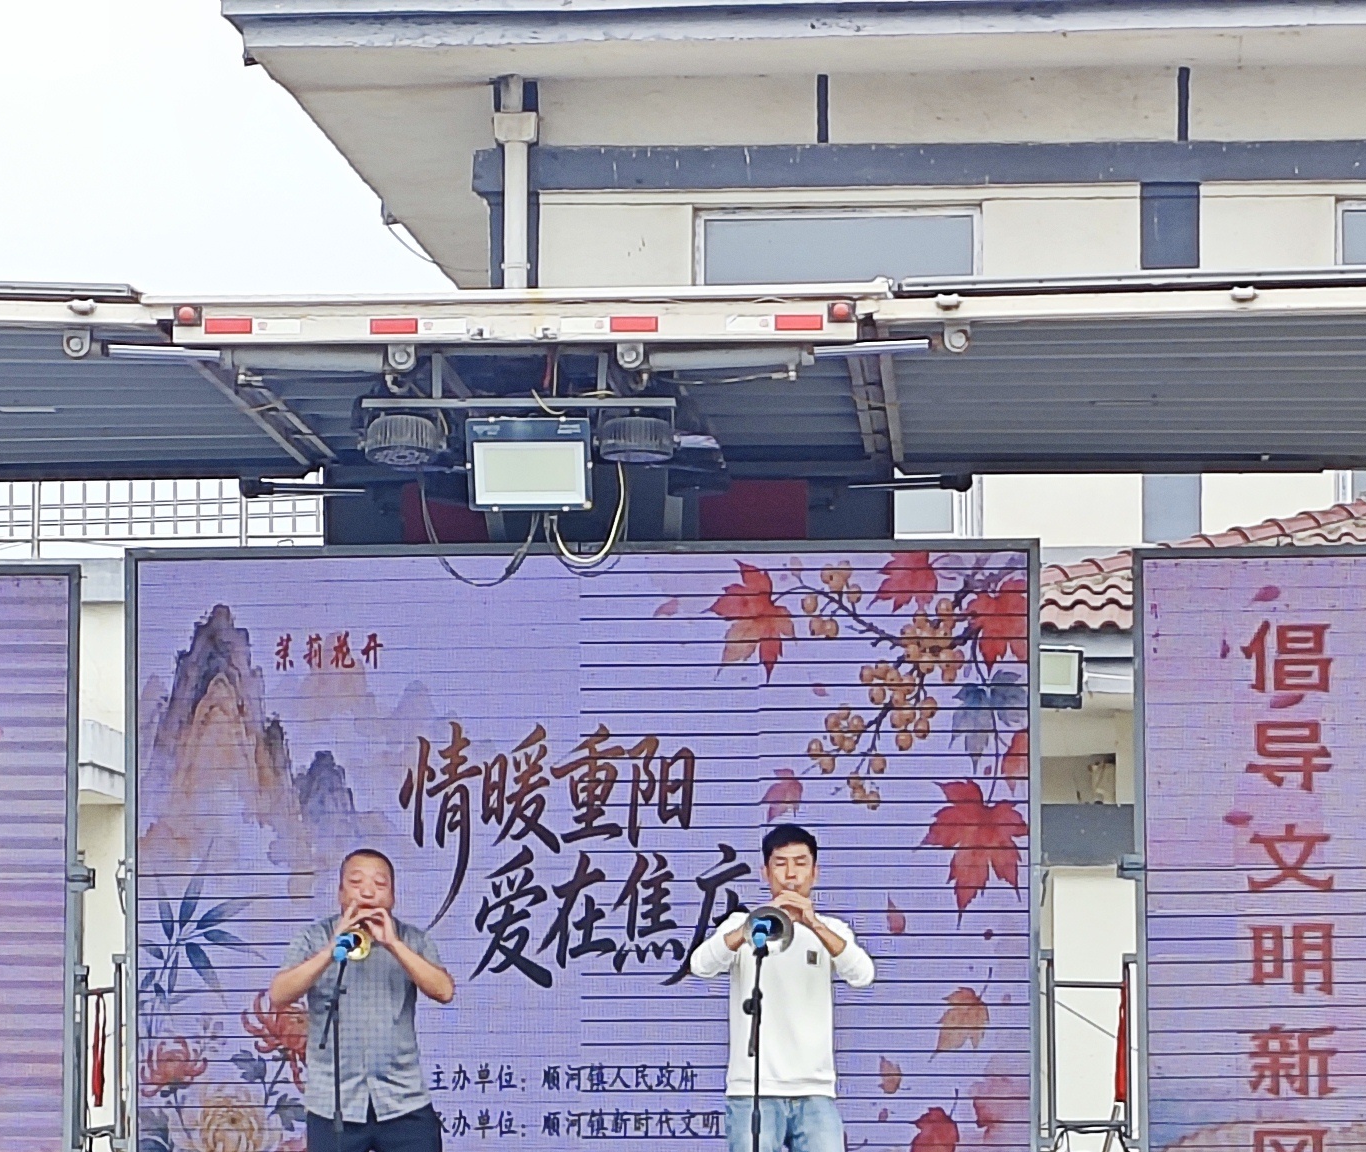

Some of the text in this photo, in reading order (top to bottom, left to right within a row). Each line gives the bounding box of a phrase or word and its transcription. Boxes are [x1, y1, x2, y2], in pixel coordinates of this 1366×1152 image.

[275, 630, 384, 671] 茉莉花开
[399, 721, 696, 930] 情暖重阳
